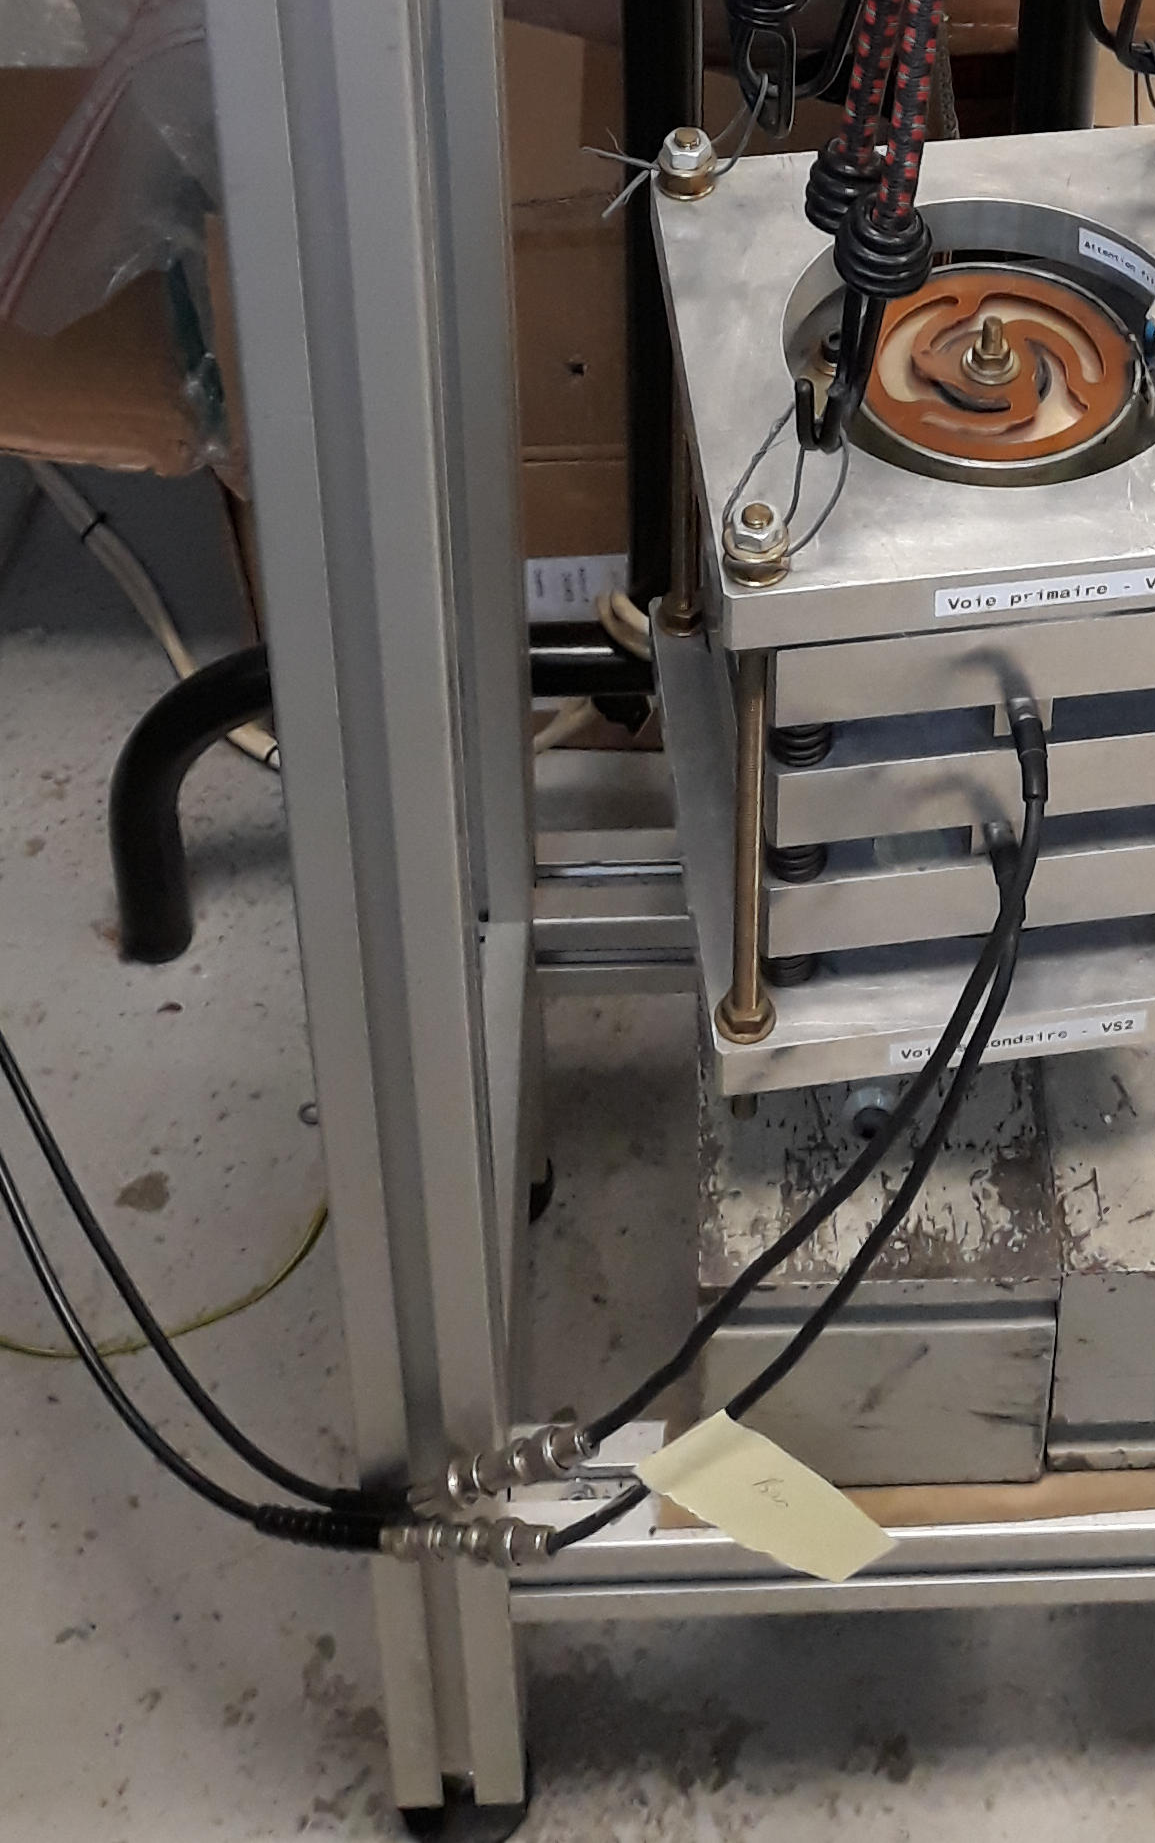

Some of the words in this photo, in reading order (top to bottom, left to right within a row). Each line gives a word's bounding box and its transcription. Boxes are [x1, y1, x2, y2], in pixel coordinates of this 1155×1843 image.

[948, 595, 997, 610] Voie
[1010, 582, 1108, 605] primaire
[901, 1046, 934, 1060] Voi
[1101, 1019, 1134, 1033] VS2
